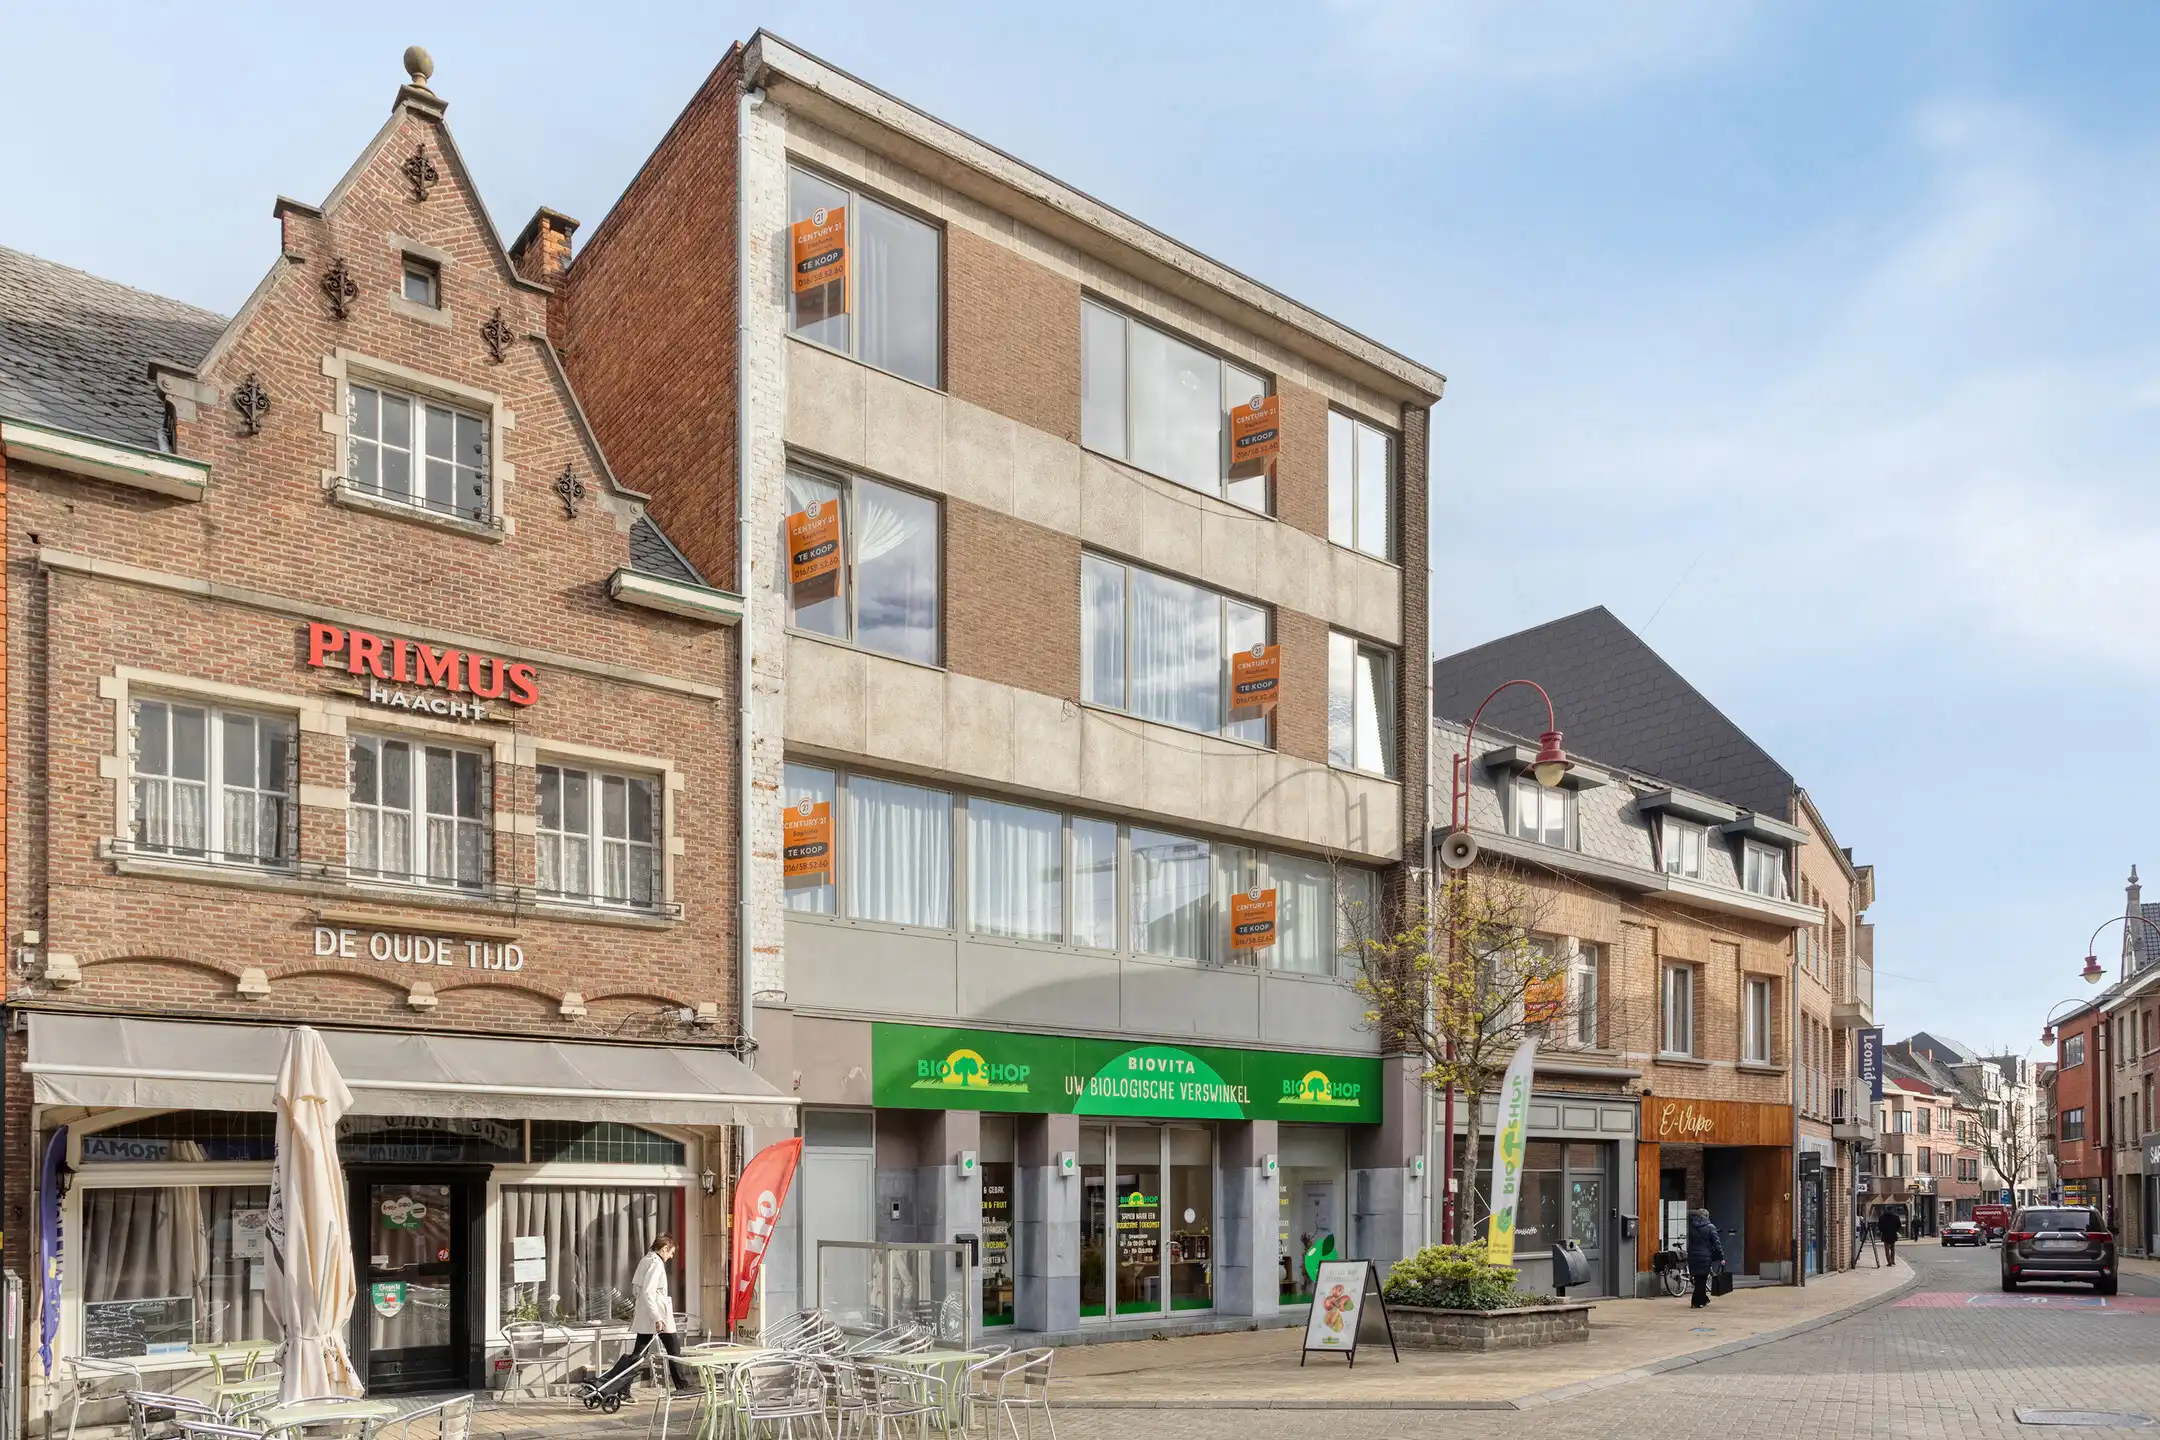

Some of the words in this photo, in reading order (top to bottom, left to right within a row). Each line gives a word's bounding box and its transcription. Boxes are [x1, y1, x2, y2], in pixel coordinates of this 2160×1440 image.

[798, 225, 834, 243] CENTURY
[802, 260, 813, 271] TE
[814, 252, 839, 267] KOOP
[1251, 431, 1274, 443] KOOP
[792, 519, 826, 536] CENTURY
[797, 551, 808, 562] TE
[809, 543, 833, 558] KOOP
[308, 621, 540, 707] PRIMUS
[1237, 659, 1270, 670] CENTURY
[1251, 681, 1273, 691] KOOP
[370, 685, 486, 720] HAACHT
[784, 818, 819, 829] CENTURY
[787, 848, 798, 857] TE
[800, 845, 823, 855] KOOP
[1236, 902, 1267, 912] CENTURY
[1249, 923, 1270, 932] KOOP
[315, 927, 357, 958] DE
[370, 932, 453, 965] OUDE
[464, 940, 524, 971] TIJD
[917, 1059, 951, 1078] BIO
[980, 1063, 1031, 1082] SHOP
[1128, 1056, 1196, 1074] BIOVITA
[1863, 1034, 1877, 1096] Leonid
[1064, 1075, 1085, 1096] UW
[1090, 1077, 1175, 1101] BIOLOGISCHE
[1179, 1081, 1251, 1105] VERSWINKEL
[1282, 1079, 1306, 1095] BIO
[1325, 1081, 1361, 1098] SHOP
[1660, 1103, 1715, 1137] E-Vape
[1783, 1192, 1791, 1200] 17
[2001, 1189, 2009, 1199] P
